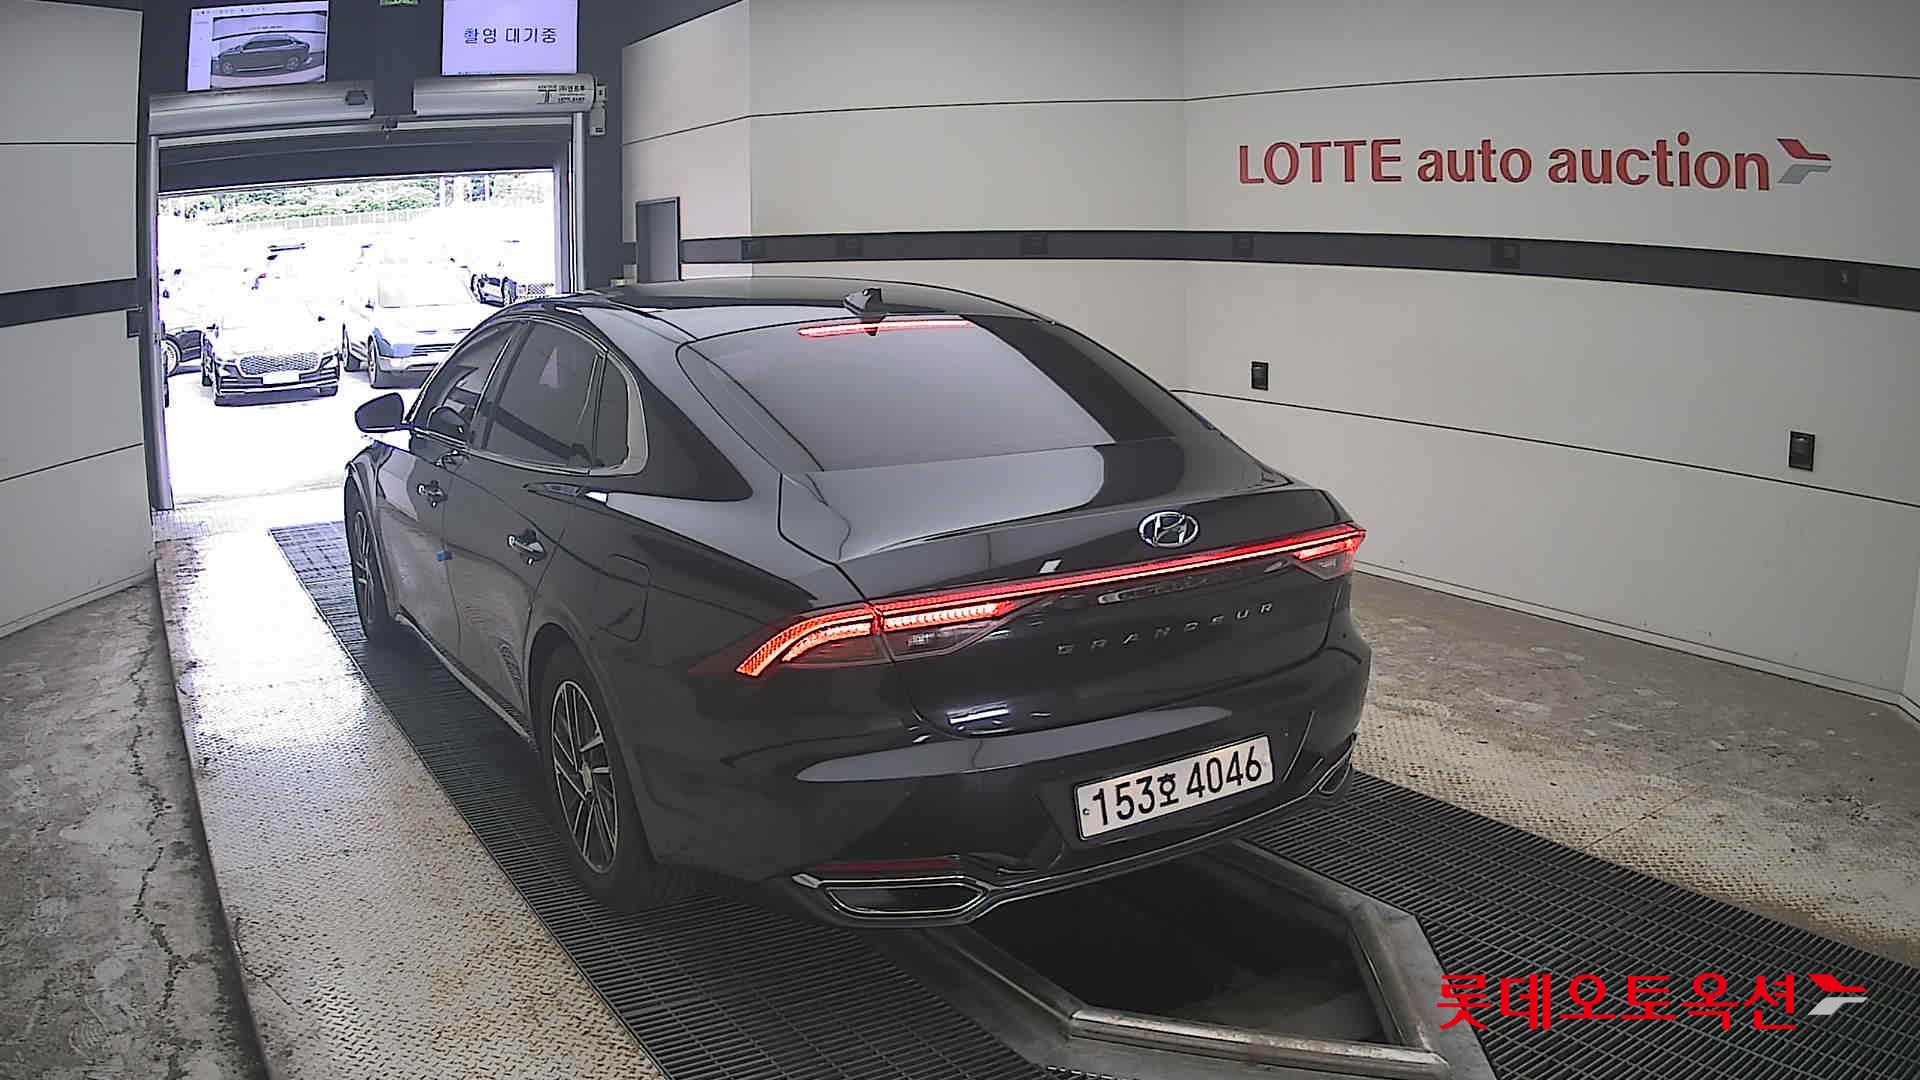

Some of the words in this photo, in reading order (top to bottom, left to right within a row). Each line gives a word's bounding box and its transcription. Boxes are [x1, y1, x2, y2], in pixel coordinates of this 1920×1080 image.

[463, 27, 498, 44] 촬영
[504, 26, 558, 44] 대기중
[1239, 139, 1402, 185] LOTTE
[1417, 139, 1532, 183] auto
[1548, 131, 1770, 191] auction
[1057, 602, 1273, 655] GRANDEUR
